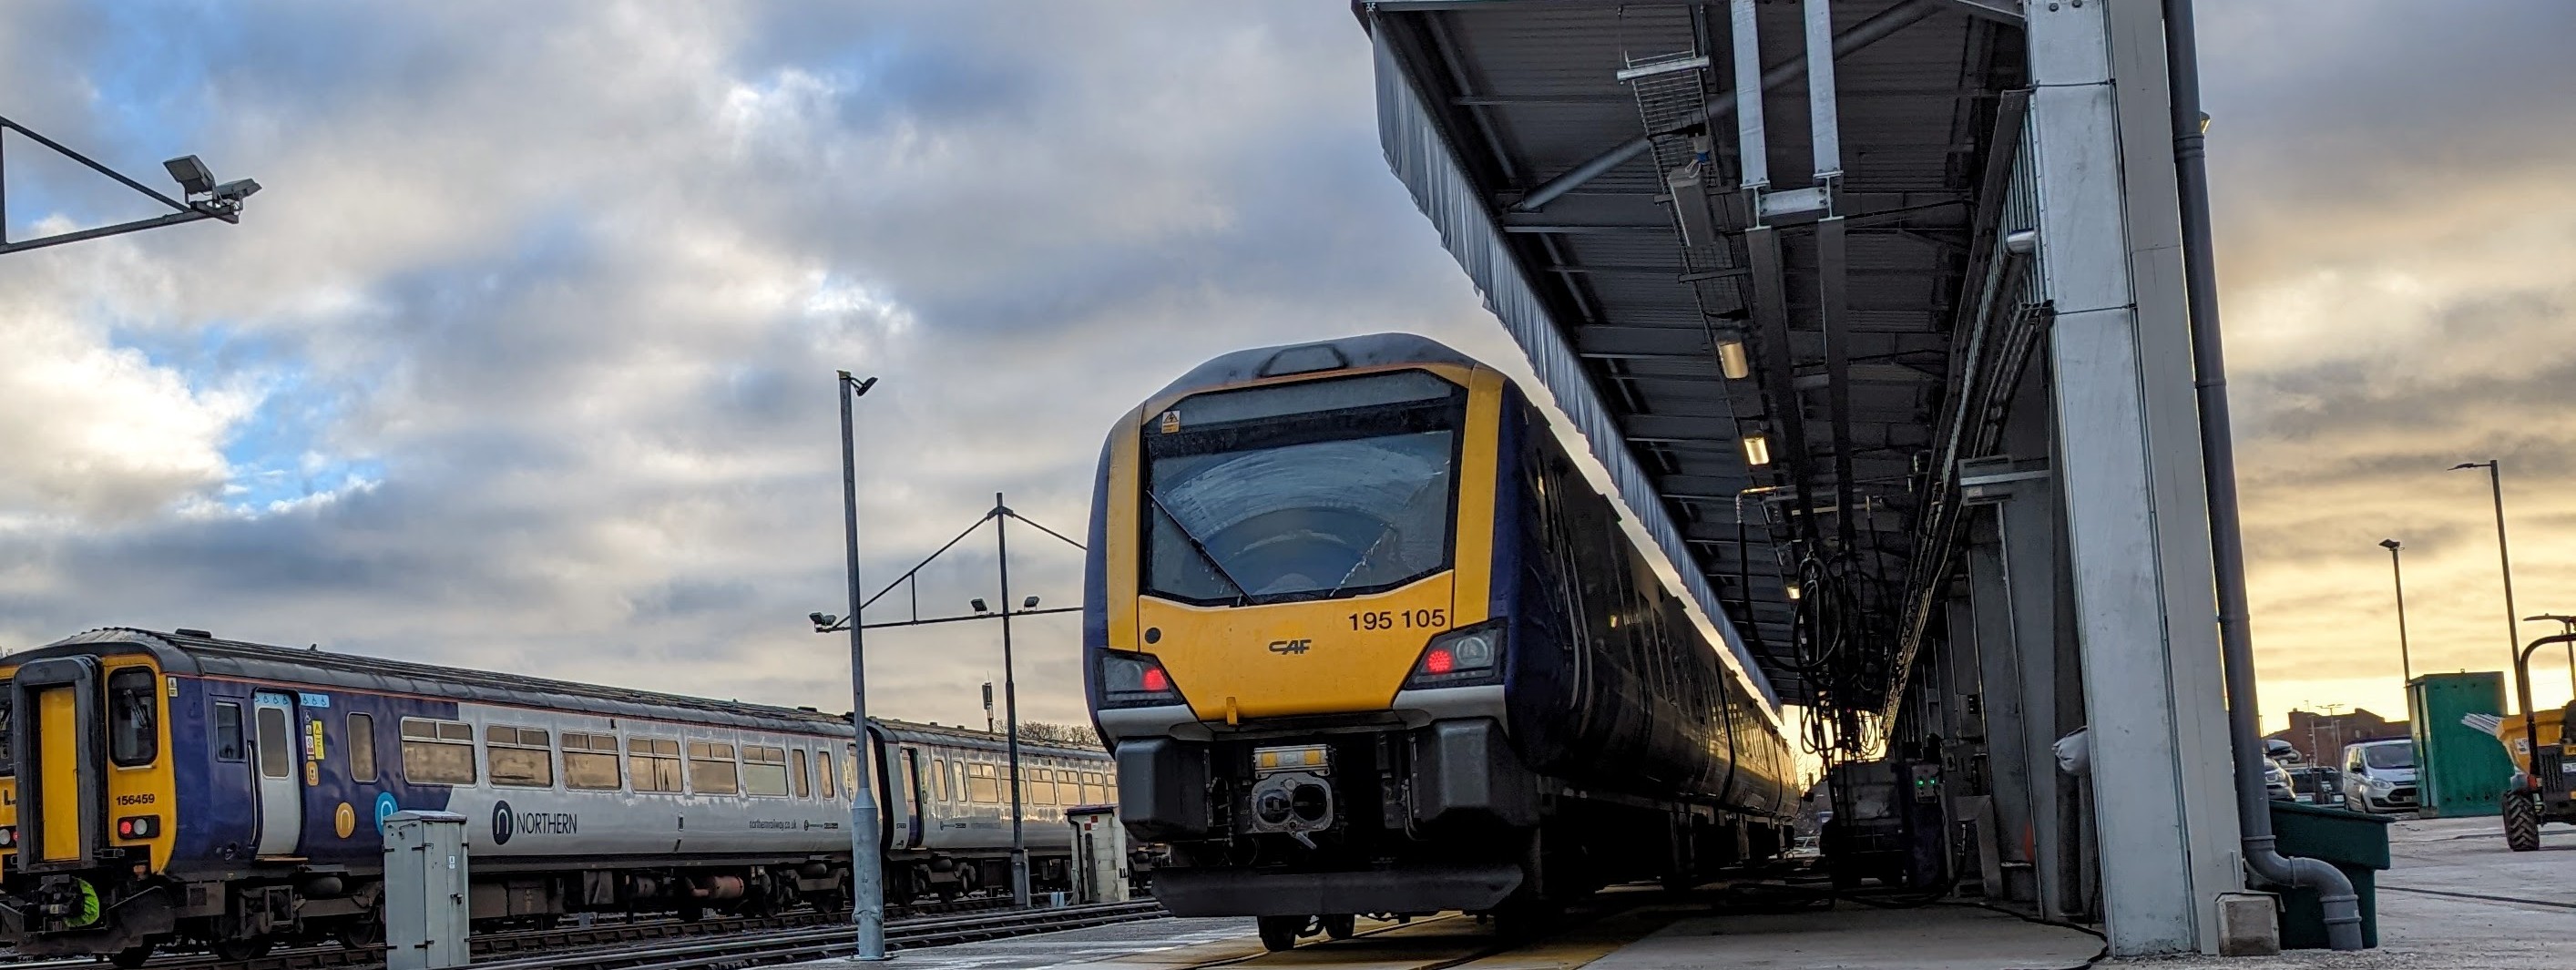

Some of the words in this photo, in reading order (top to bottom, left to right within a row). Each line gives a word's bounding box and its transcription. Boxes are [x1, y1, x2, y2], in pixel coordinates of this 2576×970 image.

[1348, 610, 1393, 631] 195
[1401, 608, 1446, 628] 105
[1269, 638, 1312, 656] CAF
[116, 793, 156, 806] 156459
[516, 812, 578, 834] NORTHERN
